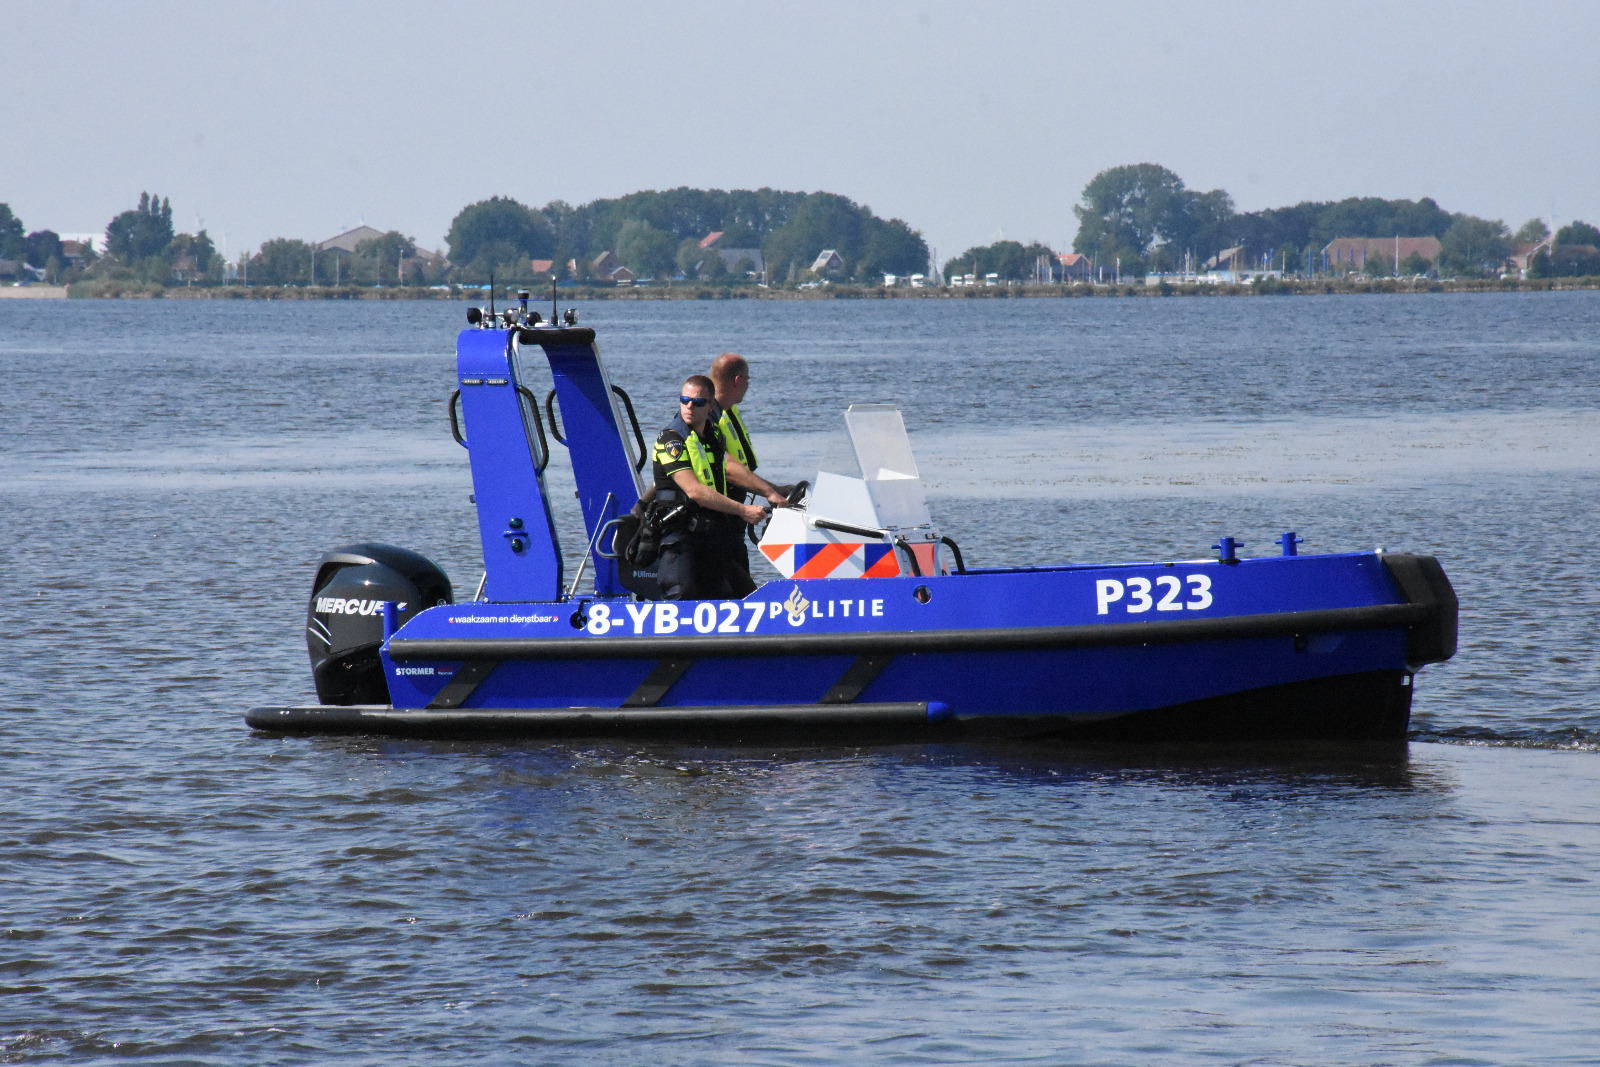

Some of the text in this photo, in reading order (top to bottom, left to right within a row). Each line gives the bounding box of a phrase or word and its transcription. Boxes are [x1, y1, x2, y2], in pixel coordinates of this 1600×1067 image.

[1096, 574, 1213, 615] P323
[316, 597, 408, 616] MERCUR
[769, 599, 884, 627] POLITIE
[455, 614, 553, 624] waakzaam en dienstbaar
[587, 602, 766, 635] 8-YB-027
[395, 667, 435, 676] STORMER
